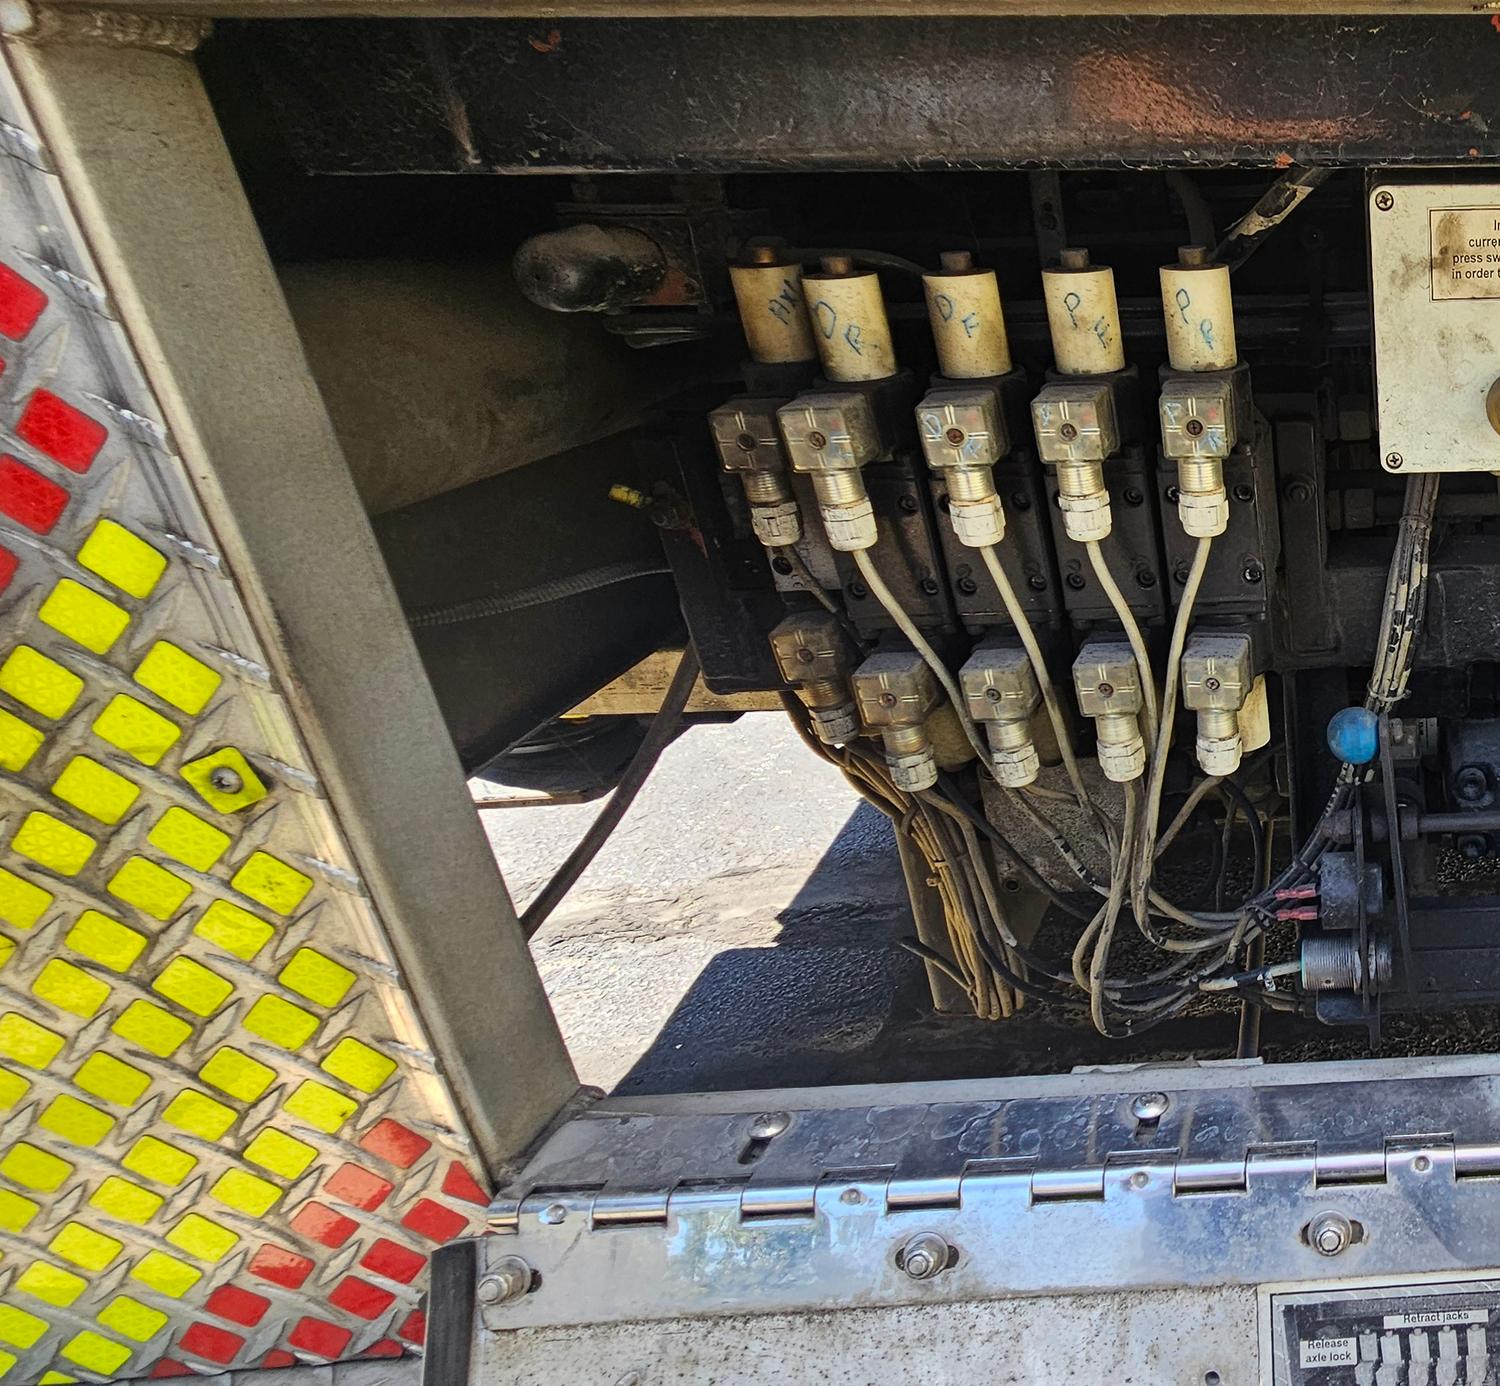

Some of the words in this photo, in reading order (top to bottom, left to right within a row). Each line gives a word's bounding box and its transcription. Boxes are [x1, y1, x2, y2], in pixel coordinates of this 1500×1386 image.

[1452, 254, 1484, 265] press
[1452, 269, 1462, 280] in
[1465, 268, 1495, 280] order
[1403, 1312, 1441, 1324] Retract
[1442, 1312, 1469, 1323] jacks
[1307, 1338, 1349, 1350] Release
[1305, 1352, 1327, 1363] axle
[1329, 1351, 1352, 1362] lock
